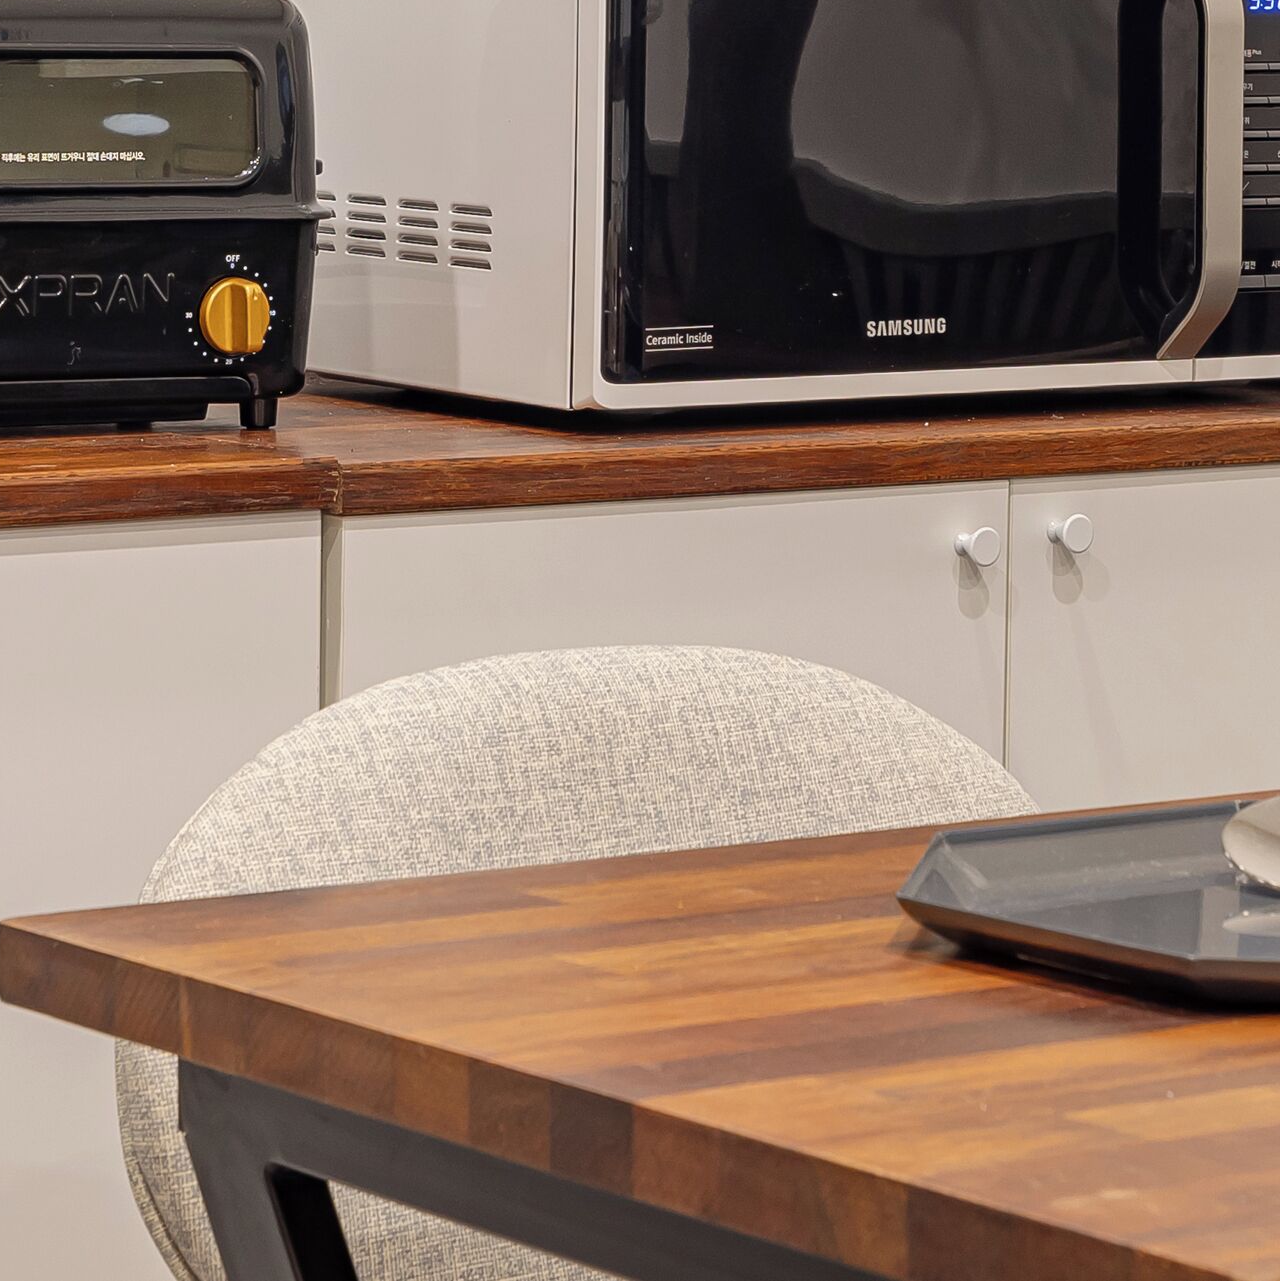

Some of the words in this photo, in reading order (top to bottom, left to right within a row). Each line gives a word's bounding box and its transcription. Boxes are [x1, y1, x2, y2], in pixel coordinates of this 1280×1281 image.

[27, 152, 40, 163] 유리
[866, 317, 946, 337] SAMSUNG
[646, 332, 684, 346] Ceramic
[686, 331, 713, 344] Inside
